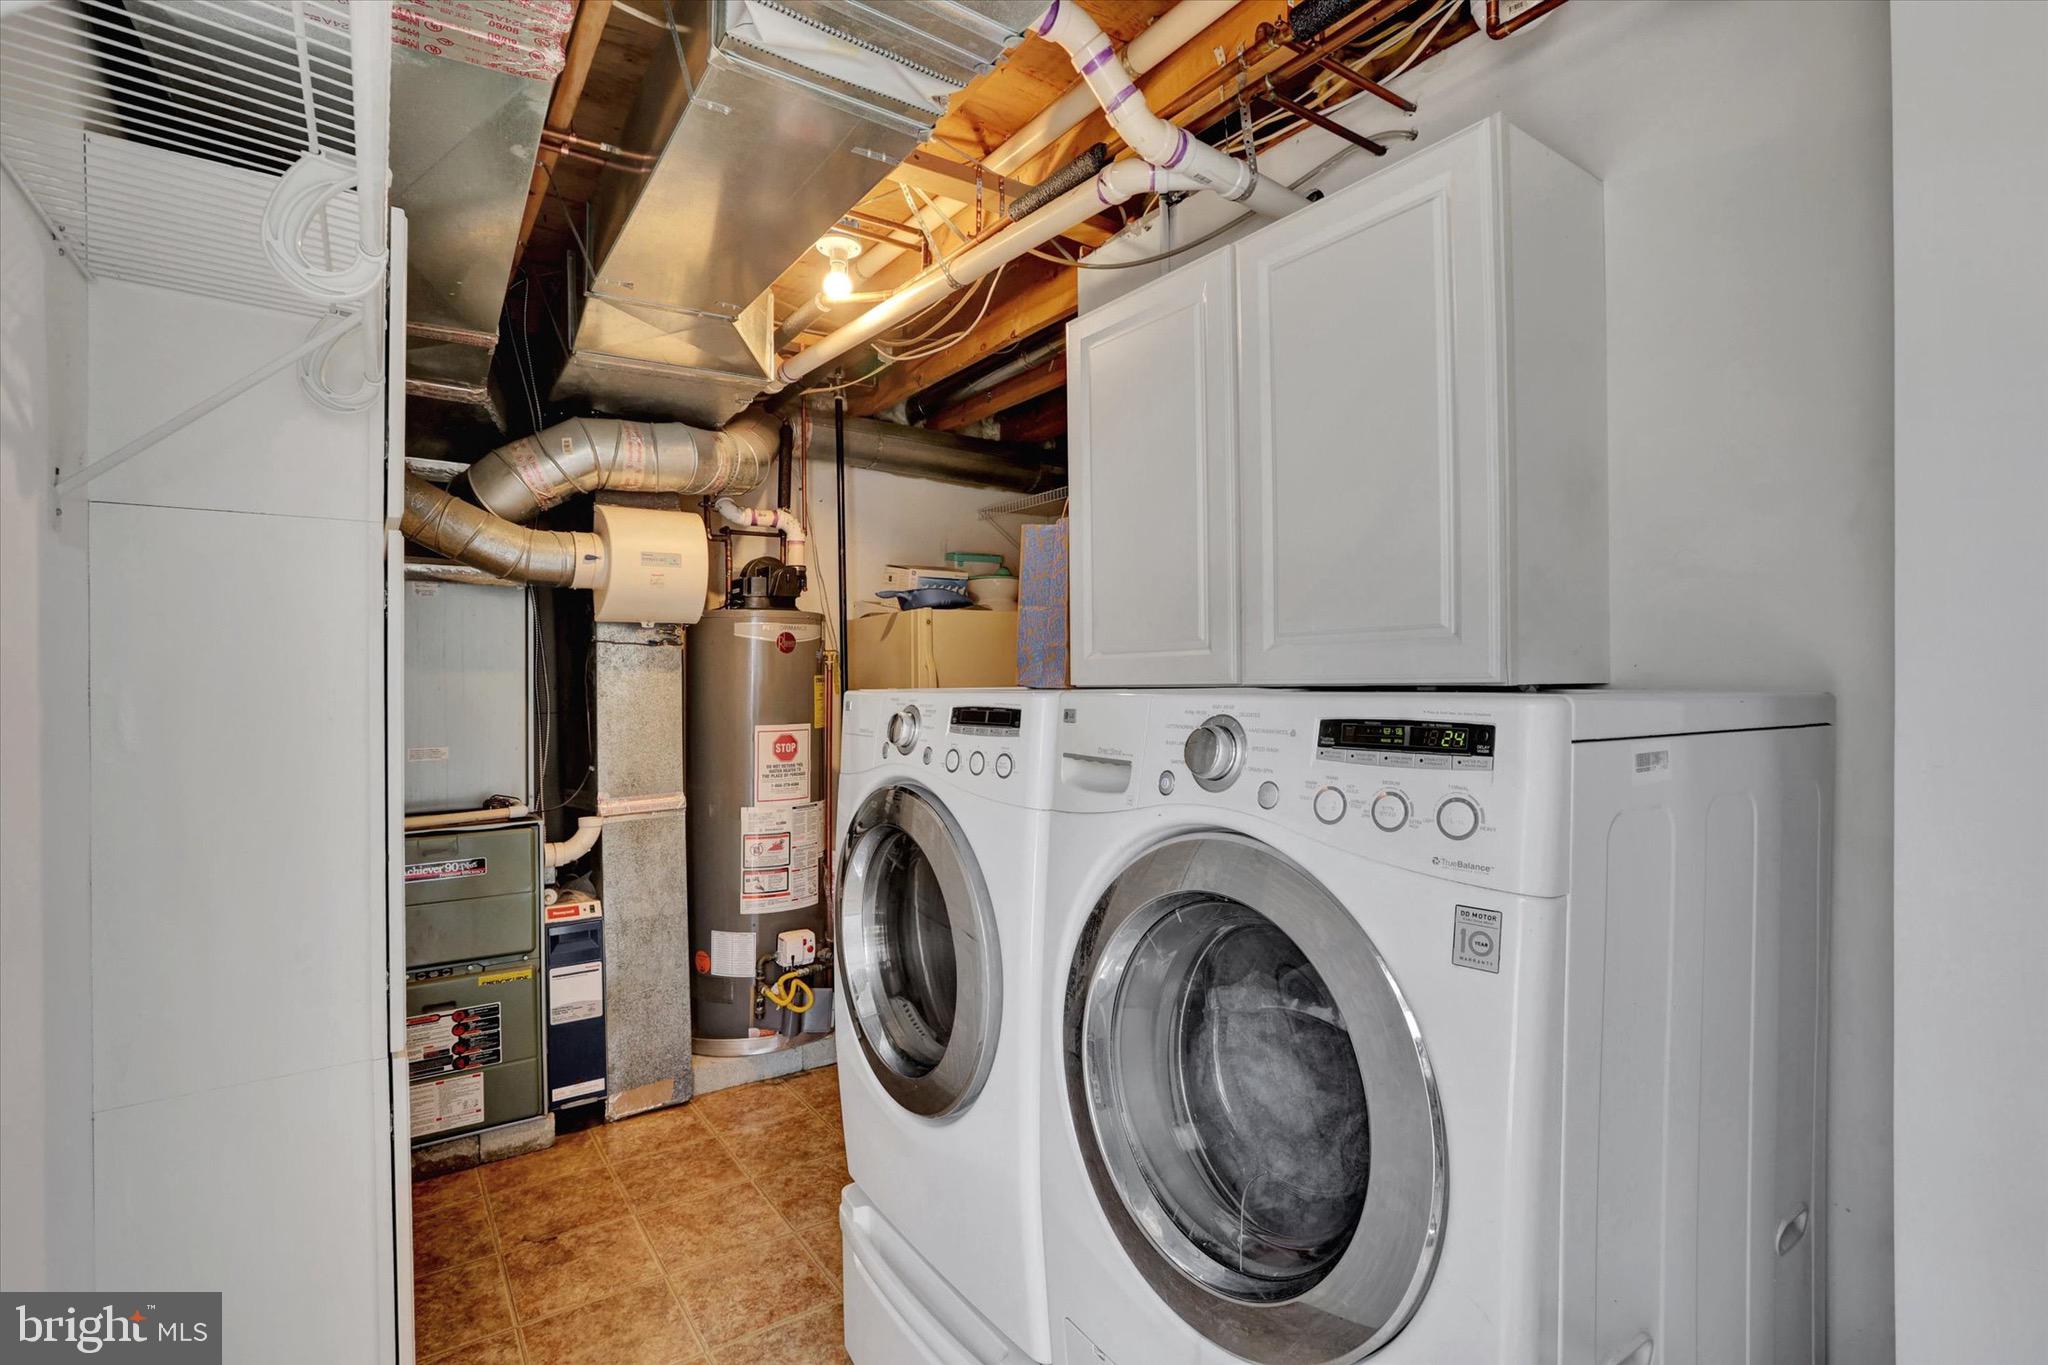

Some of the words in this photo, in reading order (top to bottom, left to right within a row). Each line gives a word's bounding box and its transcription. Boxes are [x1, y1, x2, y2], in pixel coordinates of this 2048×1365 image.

[775, 742, 797, 754] STOP
[405, 864, 443, 876] chiever
[444, 862, 459, 873] 90
[1460, 910, 1470, 918] DD
[1472, 911, 1497, 922] MOTOR
[1460, 928, 1494, 957] 10
